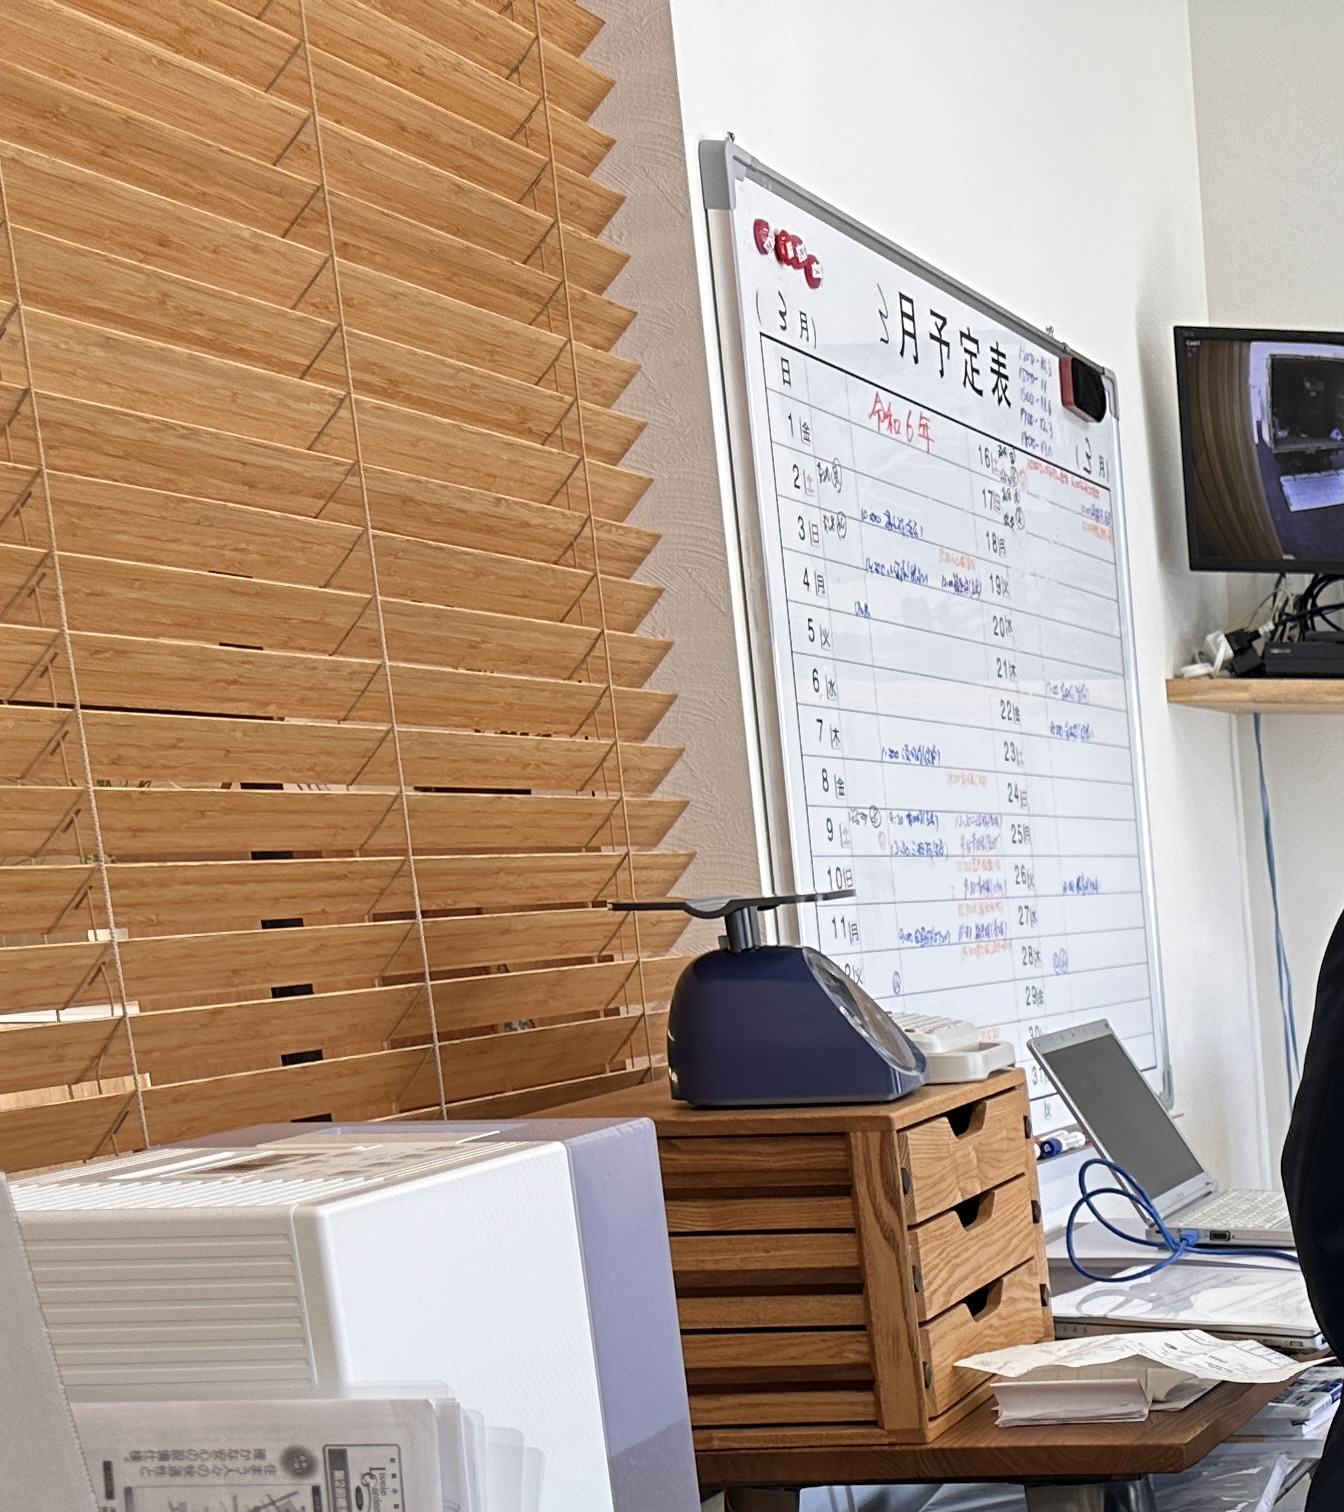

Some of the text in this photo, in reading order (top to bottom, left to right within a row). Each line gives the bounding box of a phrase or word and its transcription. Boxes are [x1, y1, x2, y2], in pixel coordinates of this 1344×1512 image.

[788, 414, 793, 436] 1
[868, 391, 934, 455] 令和6年
[978, 445, 991, 467] 16
[792, 465, 801, 489] 2
[982, 489, 995, 508] 17
[797, 516, 806, 541] 3
[986, 531, 998, 553] 18
[803, 567, 810, 591] 4
[990, 574, 1001, 595] 19
[808, 618, 815, 642] 5
[993, 615, 1005, 636] 20
[997, 658, 1009, 679] 21
[812, 669, 820, 692] 6
[1001, 700, 1013, 721] 22
[816, 720, 823, 743] 7
[1004, 741, 1016, 762] 23
[822, 769, 829, 792] 8
[1008, 782, 1019, 803] 24
[826, 819, 834, 841] 9
[1011, 824, 1023, 844] 25
[827, 867, 843, 890] 10
[1014, 864, 1026, 885] 26
[1018, 905, 1029, 925] 27
[832, 916, 846, 939] 11
[1022, 946, 1033, 966] 28
[1026, 986, 1036, 1006] 29
